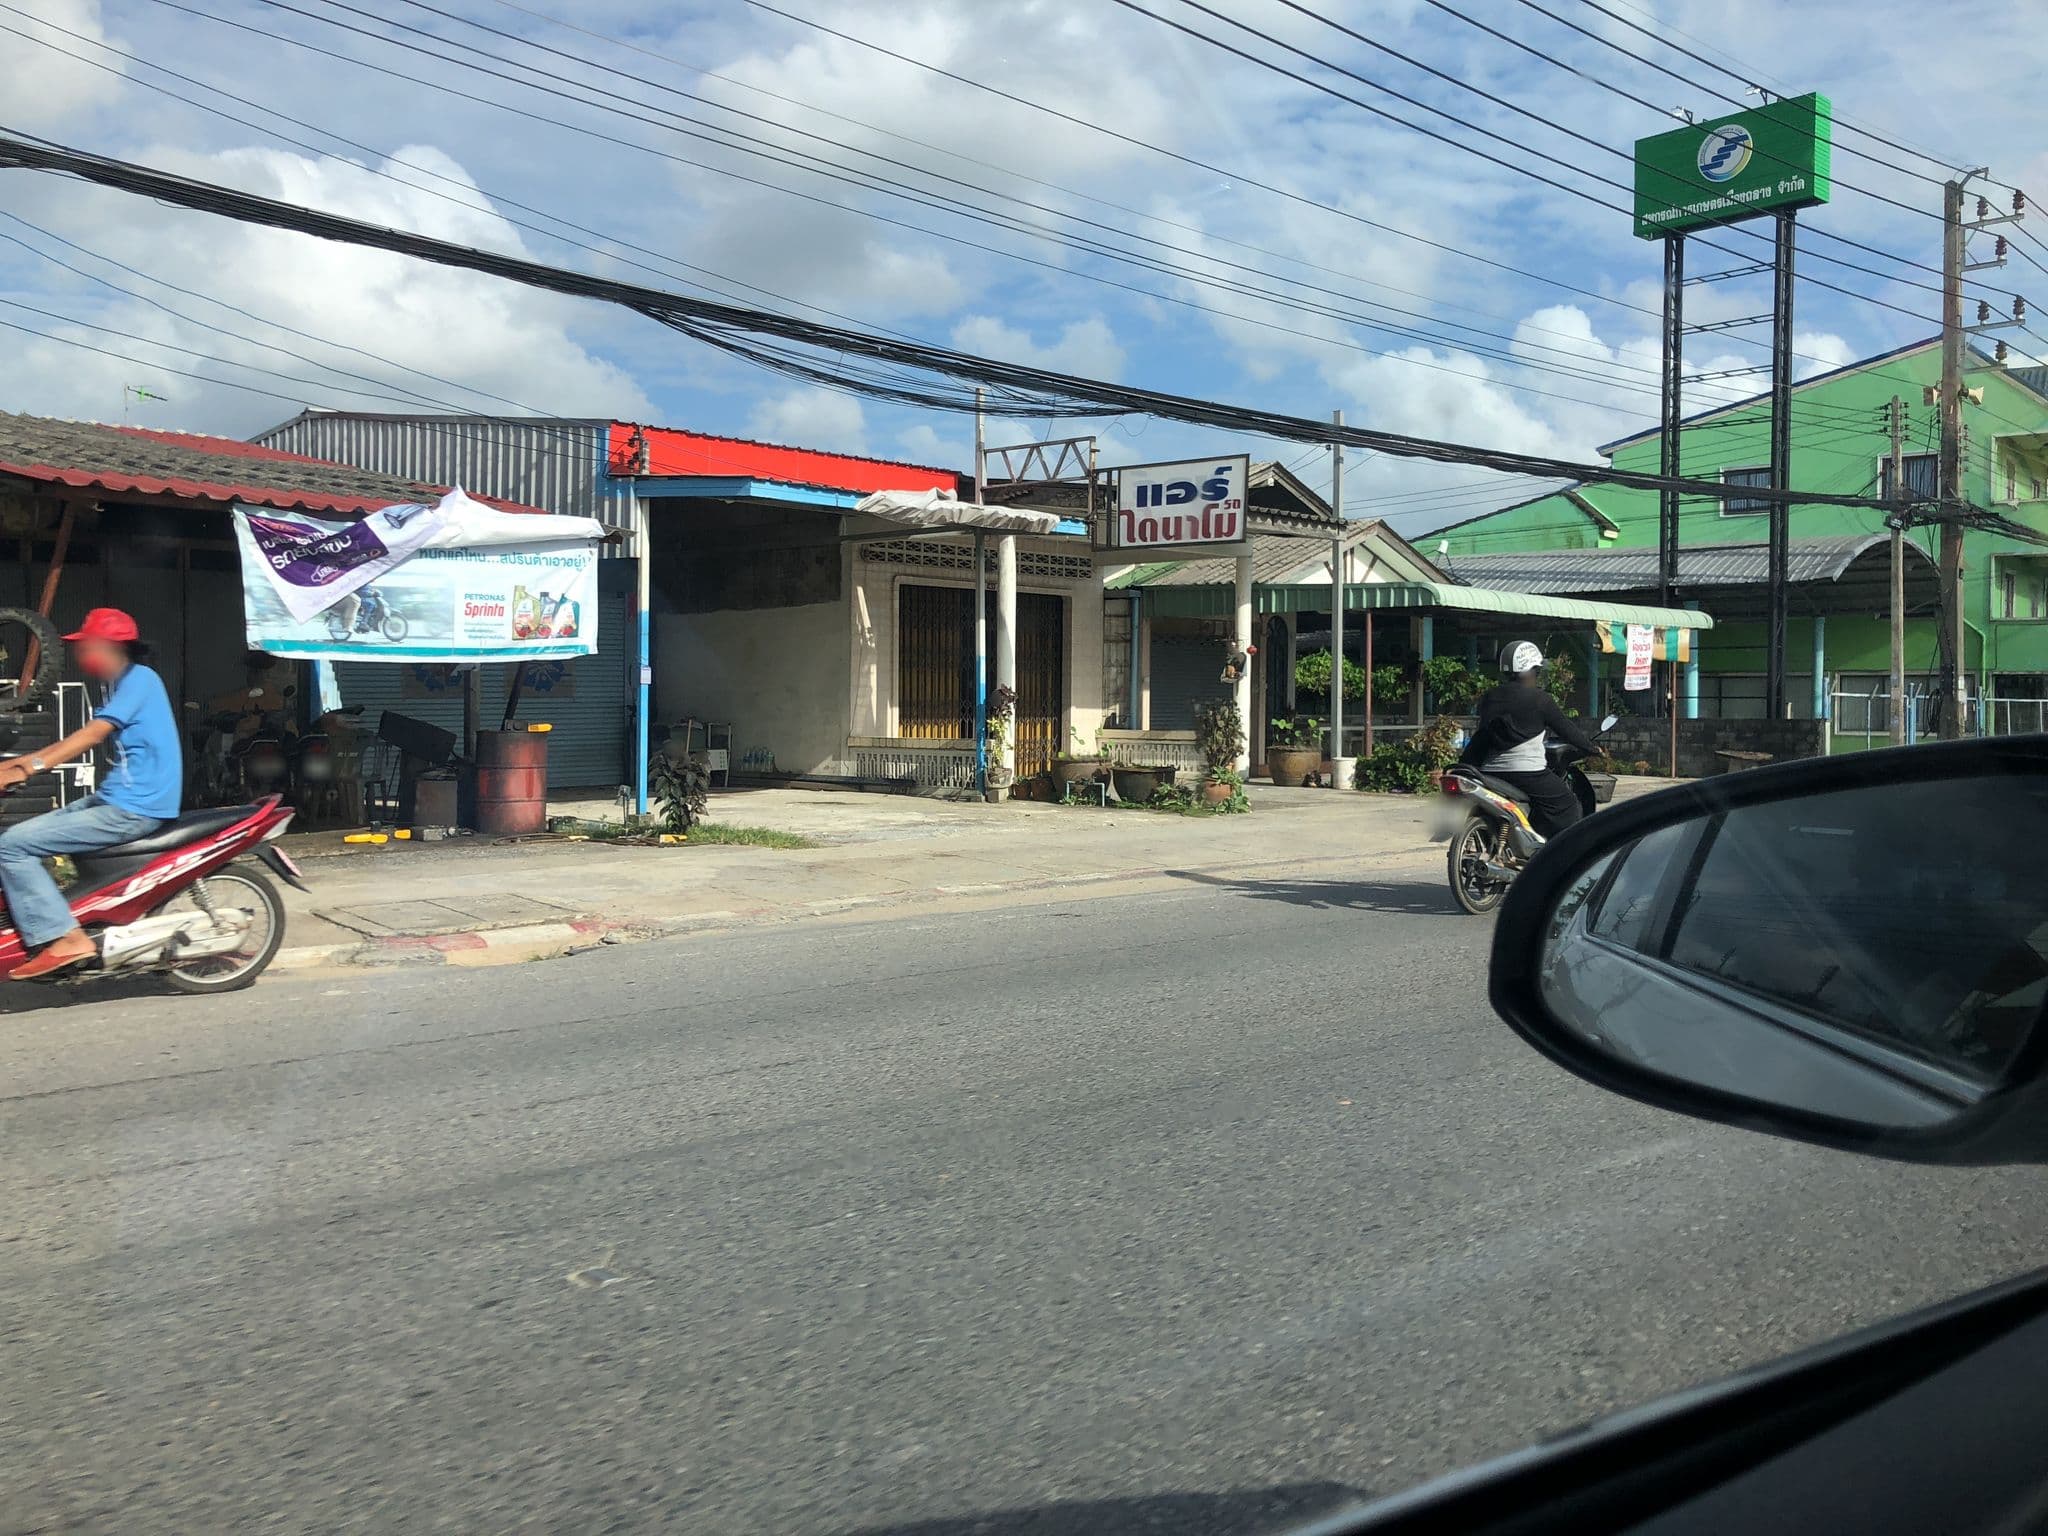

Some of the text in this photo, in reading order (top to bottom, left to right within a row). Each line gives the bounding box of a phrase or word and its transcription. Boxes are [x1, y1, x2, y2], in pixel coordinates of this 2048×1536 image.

[1778, 175, 1806, 194] จำกัด
[1136, 466, 1232, 507] แอร์
[1223, 498, 1241, 510] รถ
[1120, 503, 1236, 543] ไดนาโม
[464, 593, 506, 601] PETRONAS
[464, 602, 505, 618] Sprinta
